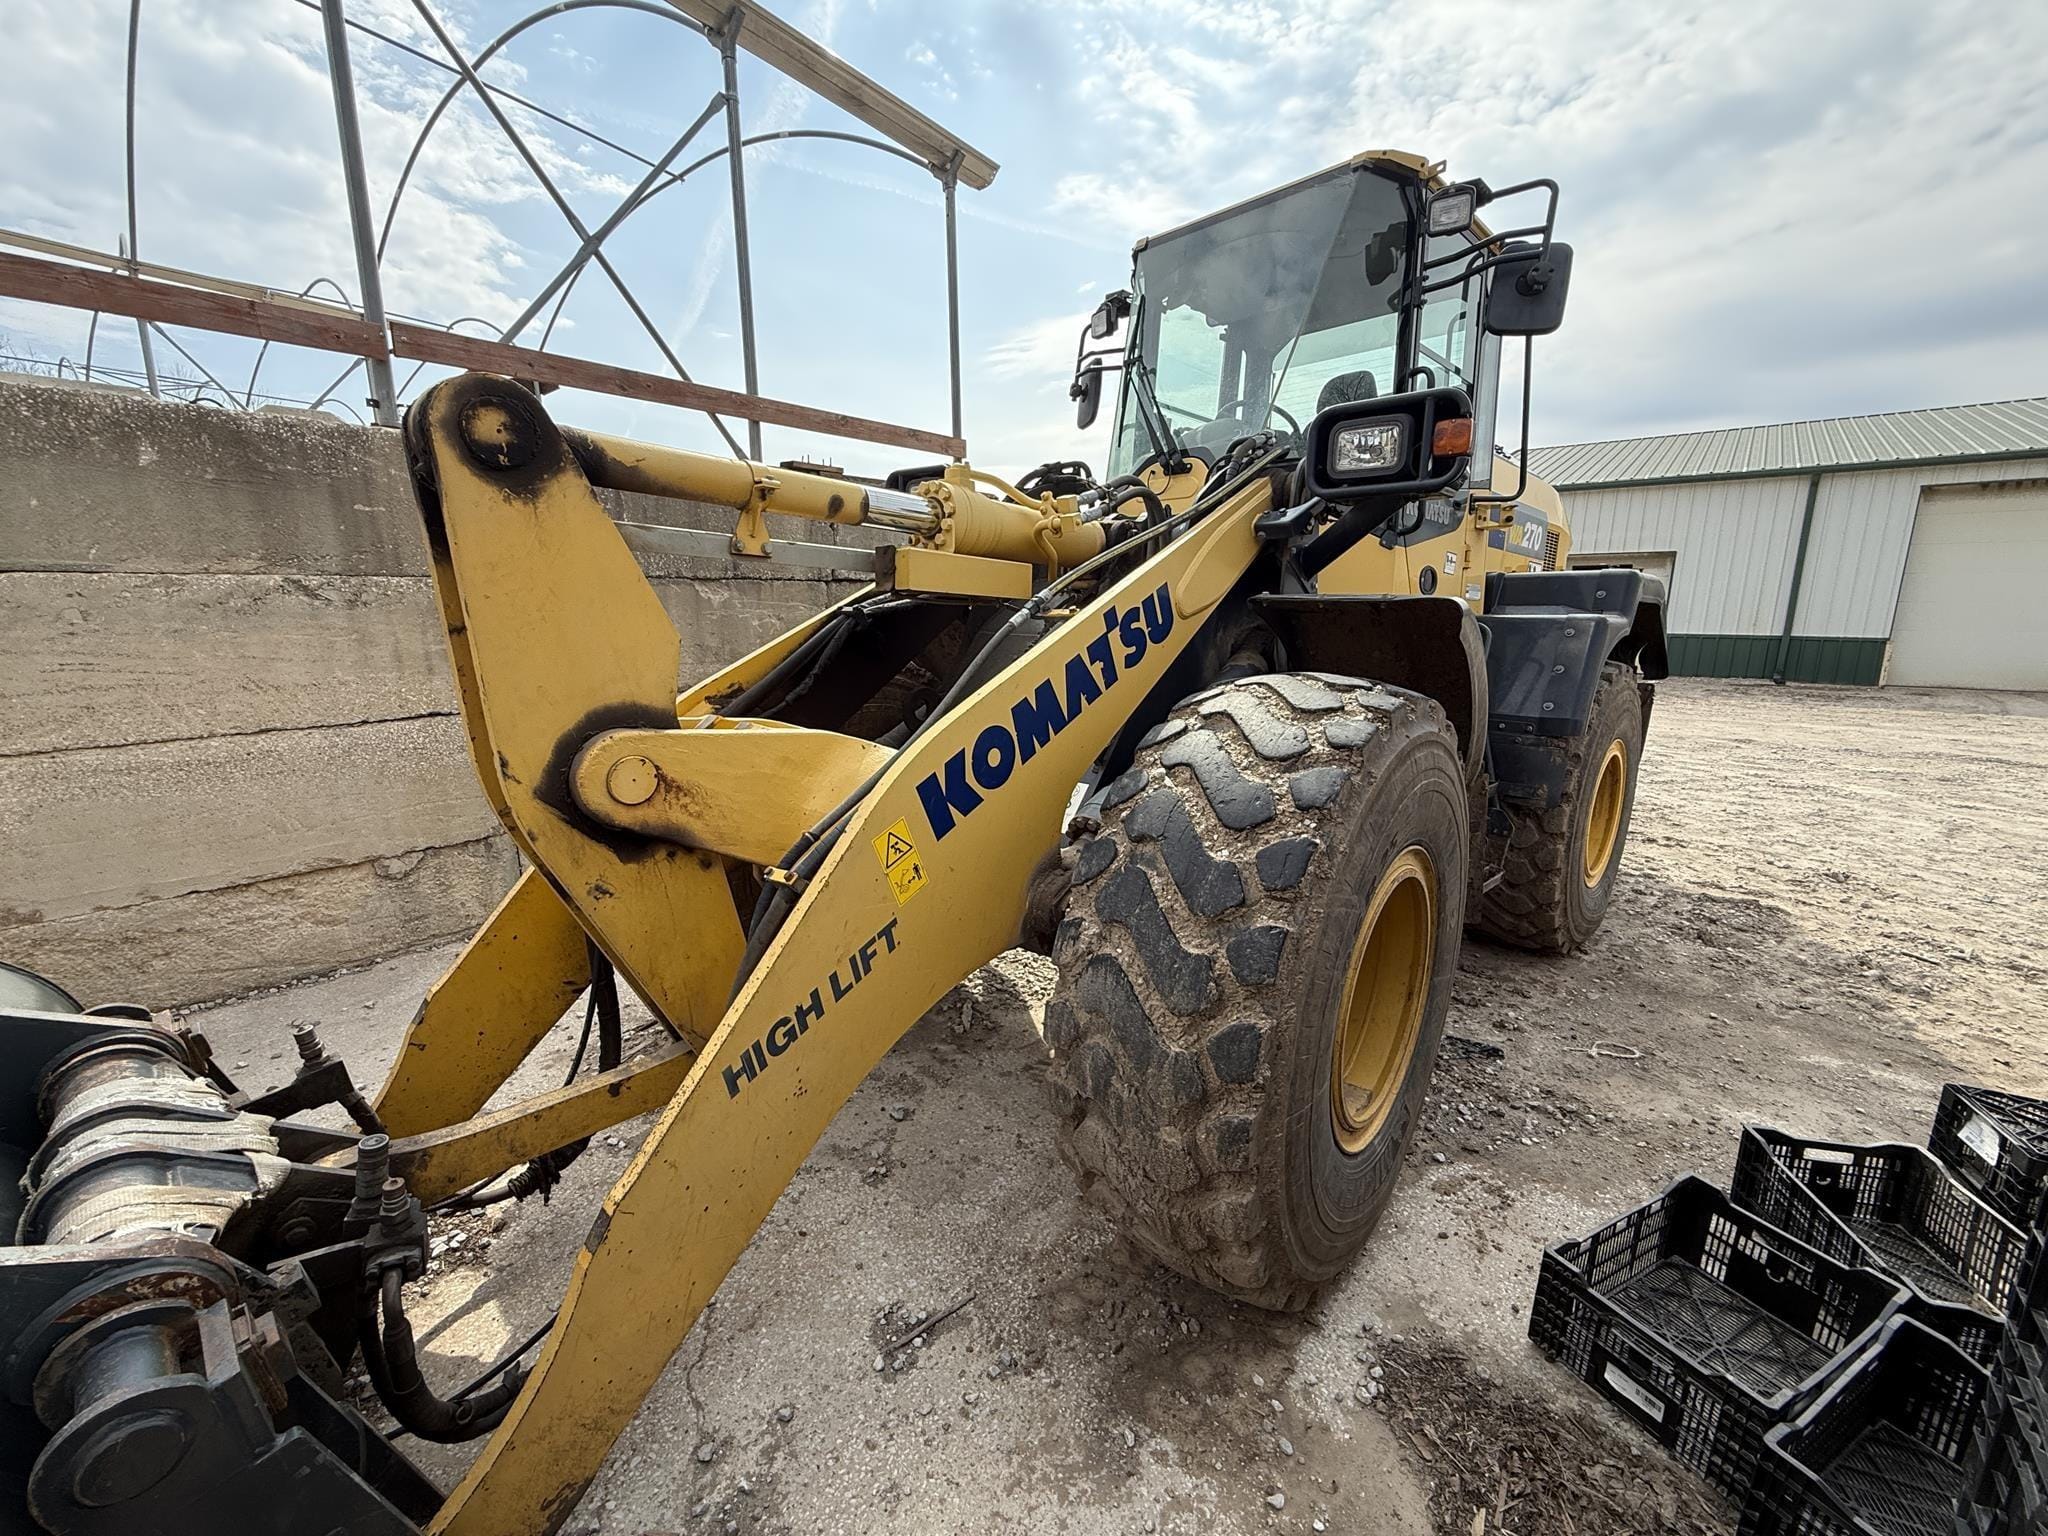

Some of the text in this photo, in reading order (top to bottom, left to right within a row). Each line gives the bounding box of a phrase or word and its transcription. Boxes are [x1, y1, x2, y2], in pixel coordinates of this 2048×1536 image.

[915, 582, 1174, 842] KOMATSU
[721, 917, 898, 1100] HIGH LIFT
